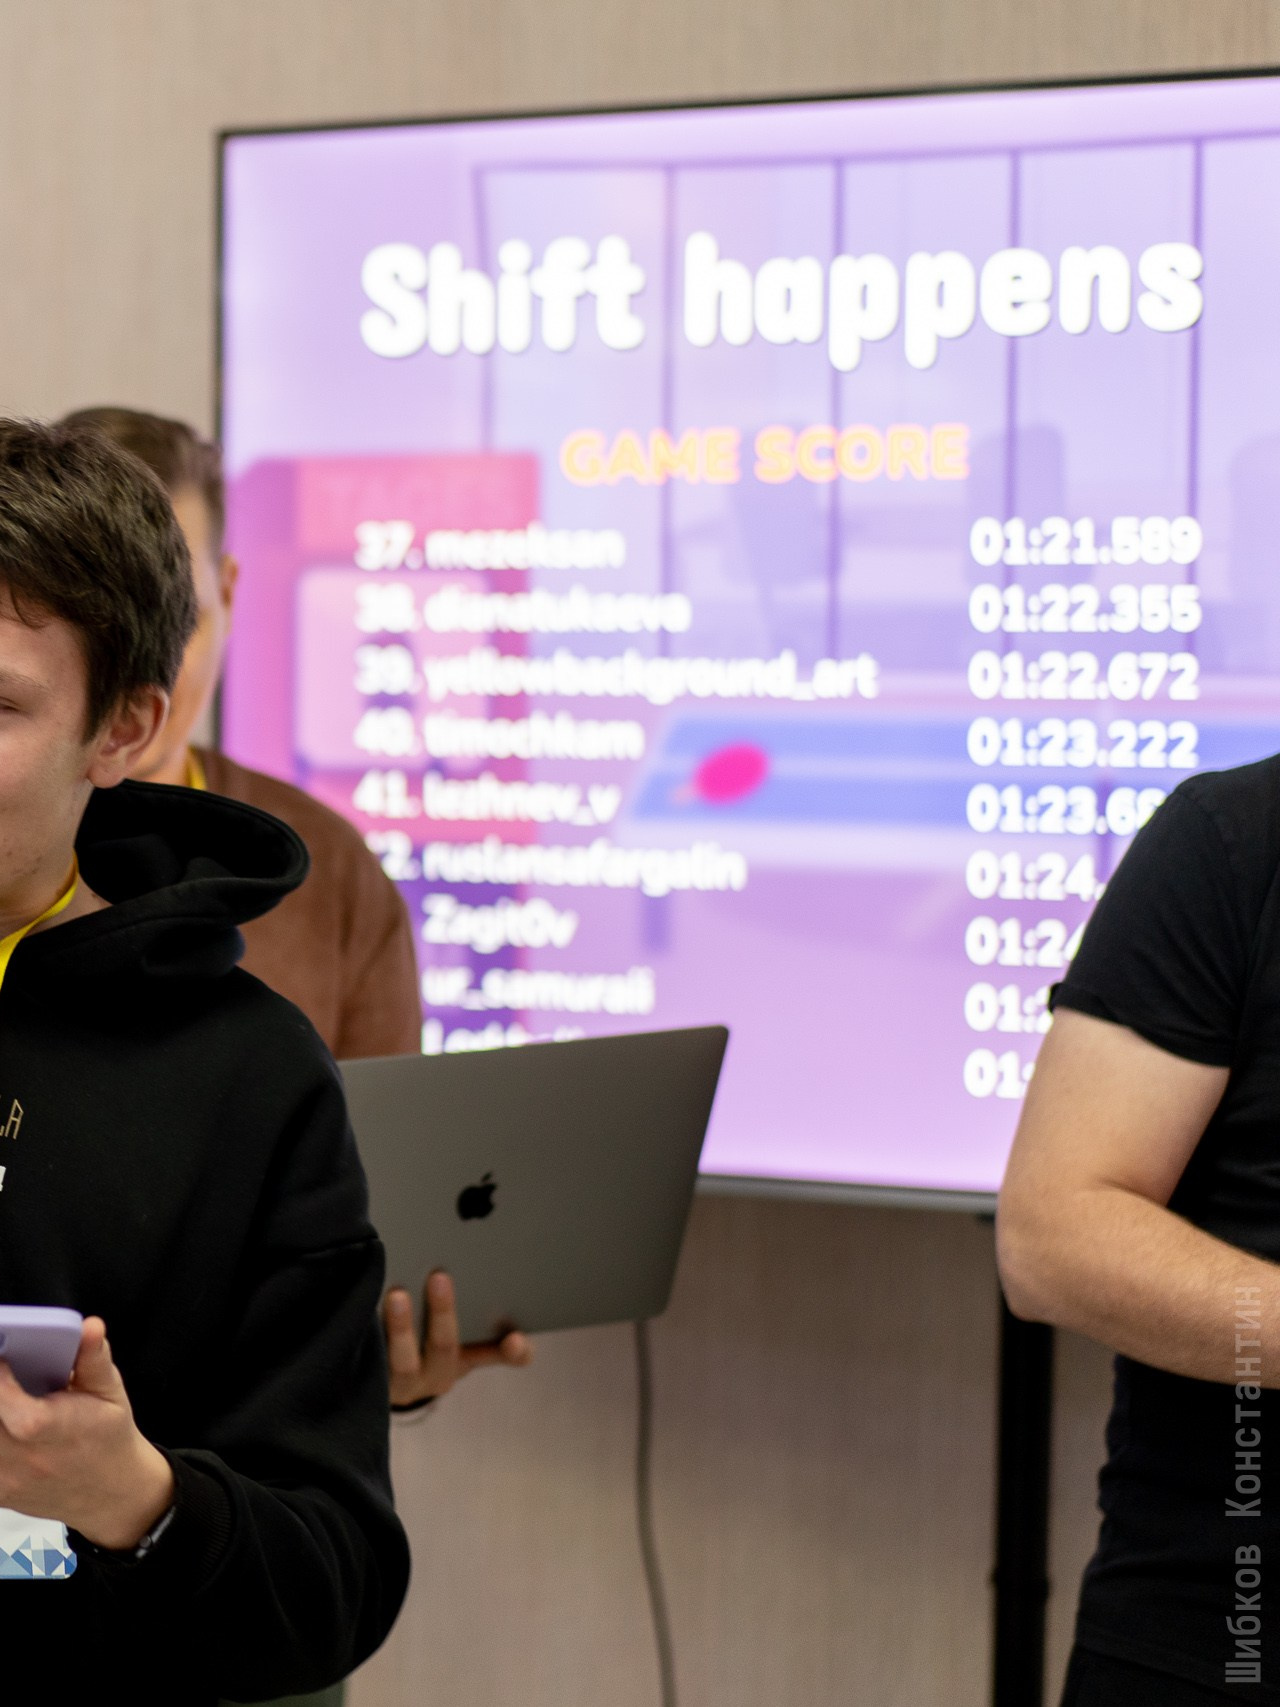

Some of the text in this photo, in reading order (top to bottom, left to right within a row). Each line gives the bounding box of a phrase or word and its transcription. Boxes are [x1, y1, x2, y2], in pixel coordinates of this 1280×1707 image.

[360, 231, 1204, 372] Shift happens
[560, 423, 970, 486] GAME SCORE
[355, 519, 422, 570] 37.
[969, 515, 1203, 567] 01:21.589
[968, 583, 1203, 634] 01:22.355
[967, 649, 1199, 701] 01:22.672
[967, 717, 1199, 769] 01:23.222
[354, 769, 418, 820] 41.
[966, 783, 1169, 837] 01:23.6
[365, 829, 419, 882] 2.
[965, 850, 1107, 902] 01:24.
